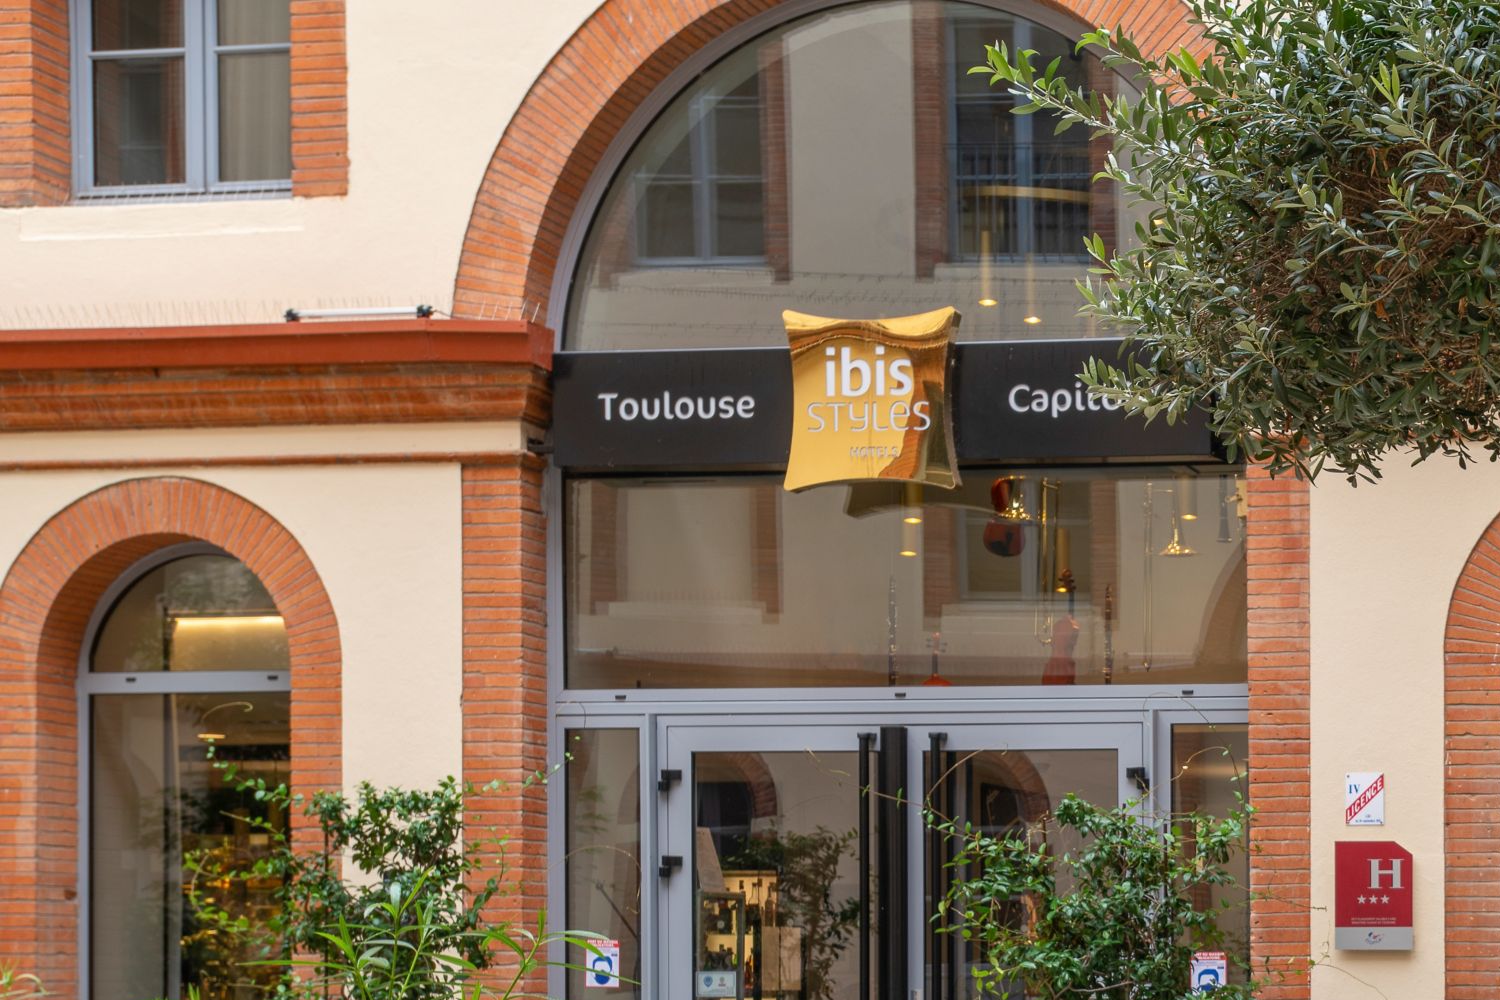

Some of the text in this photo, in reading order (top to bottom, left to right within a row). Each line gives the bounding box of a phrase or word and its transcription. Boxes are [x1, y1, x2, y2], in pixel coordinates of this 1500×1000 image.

[825, 346, 912, 397] ibis
[598, 390, 755, 421] Toulouse
[850, 446, 899, 459] HOTELS
[1347, 776, 1384, 821] LICENCE
[1348, 783, 1361, 794] IV
[1366, 858, 1405, 889] H
